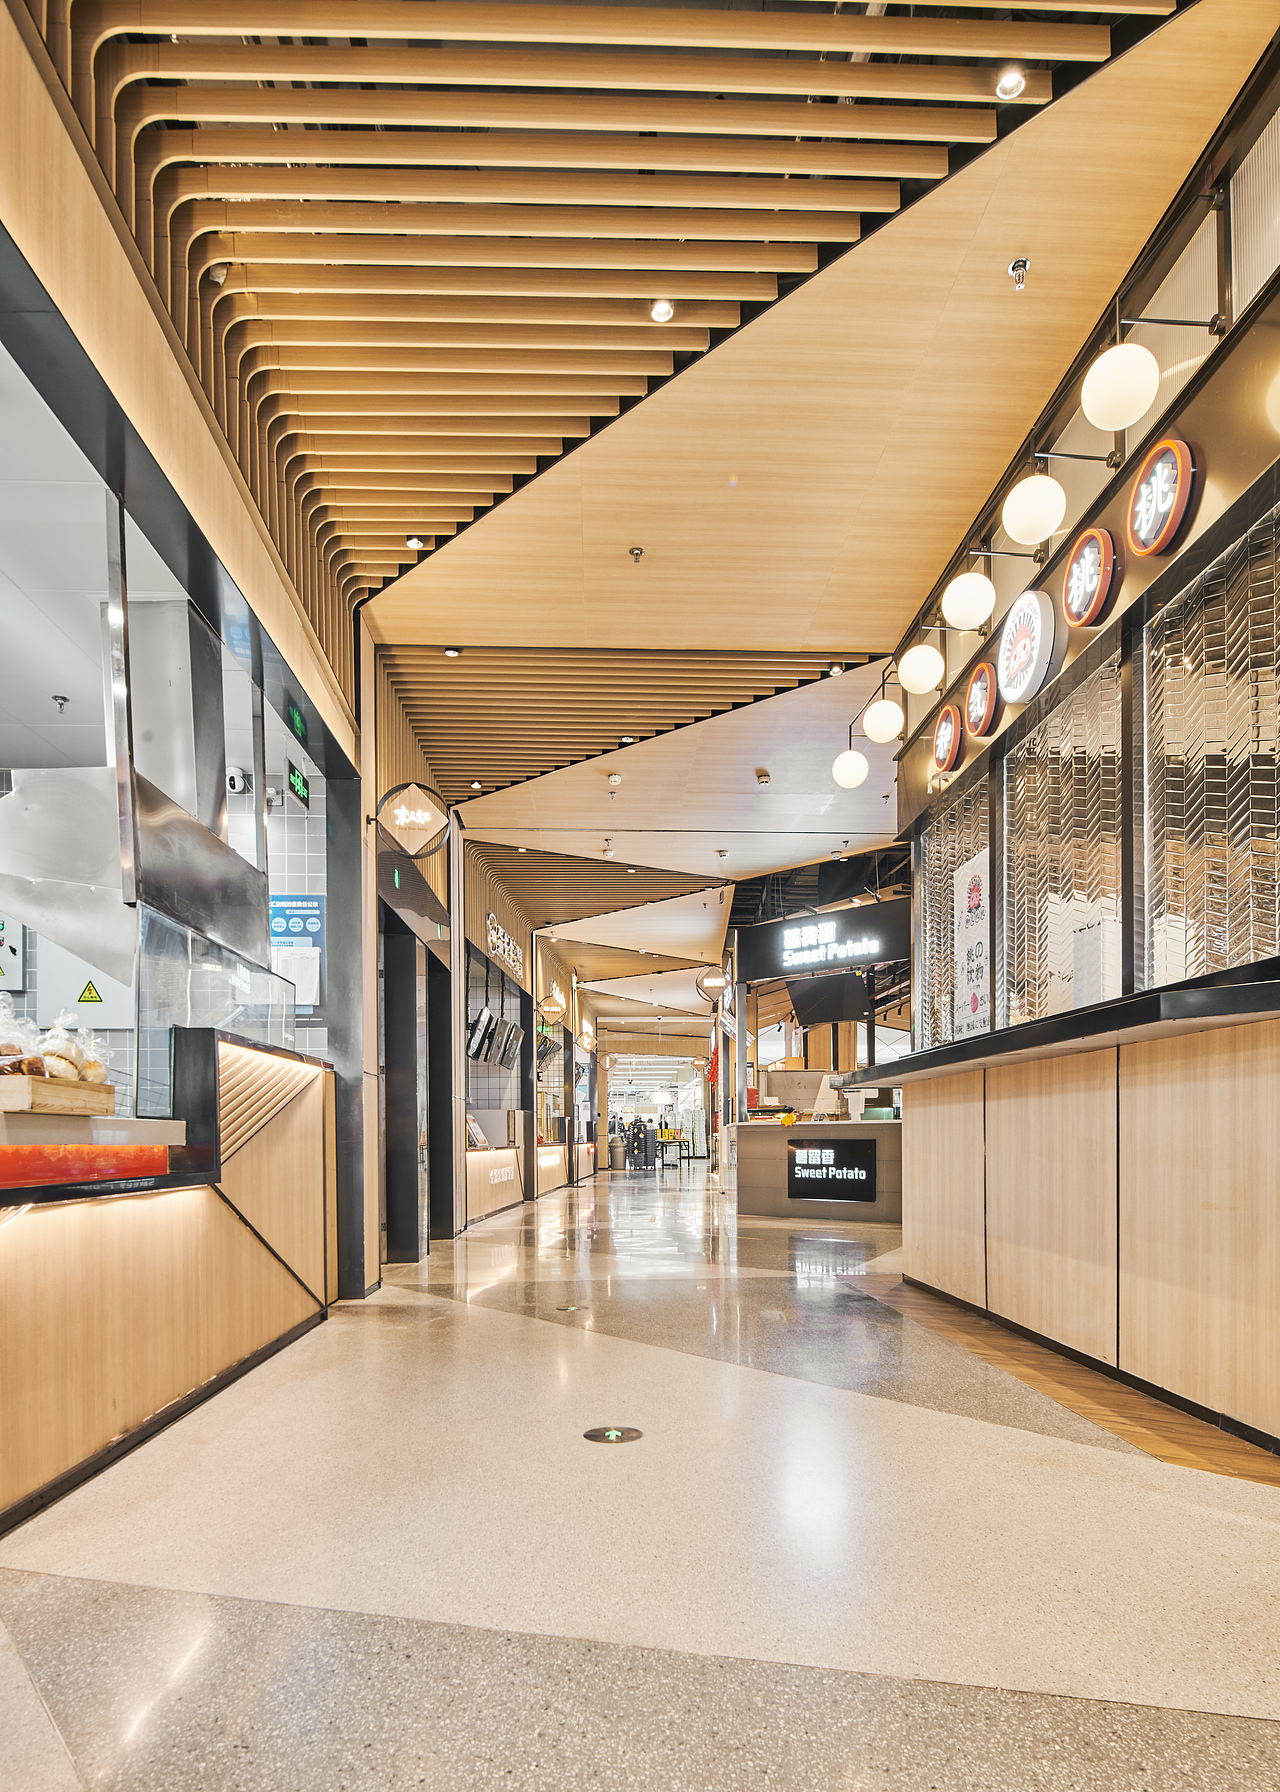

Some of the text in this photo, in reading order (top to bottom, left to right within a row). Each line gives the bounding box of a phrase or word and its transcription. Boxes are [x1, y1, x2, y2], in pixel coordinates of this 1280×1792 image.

[1068, 549, 1098, 613] 桃
[1134, 462, 1175, 540] 桃
[782, 937, 880, 967] Sweet Potato
[794, 1166, 867, 1180] Sweet Potato
